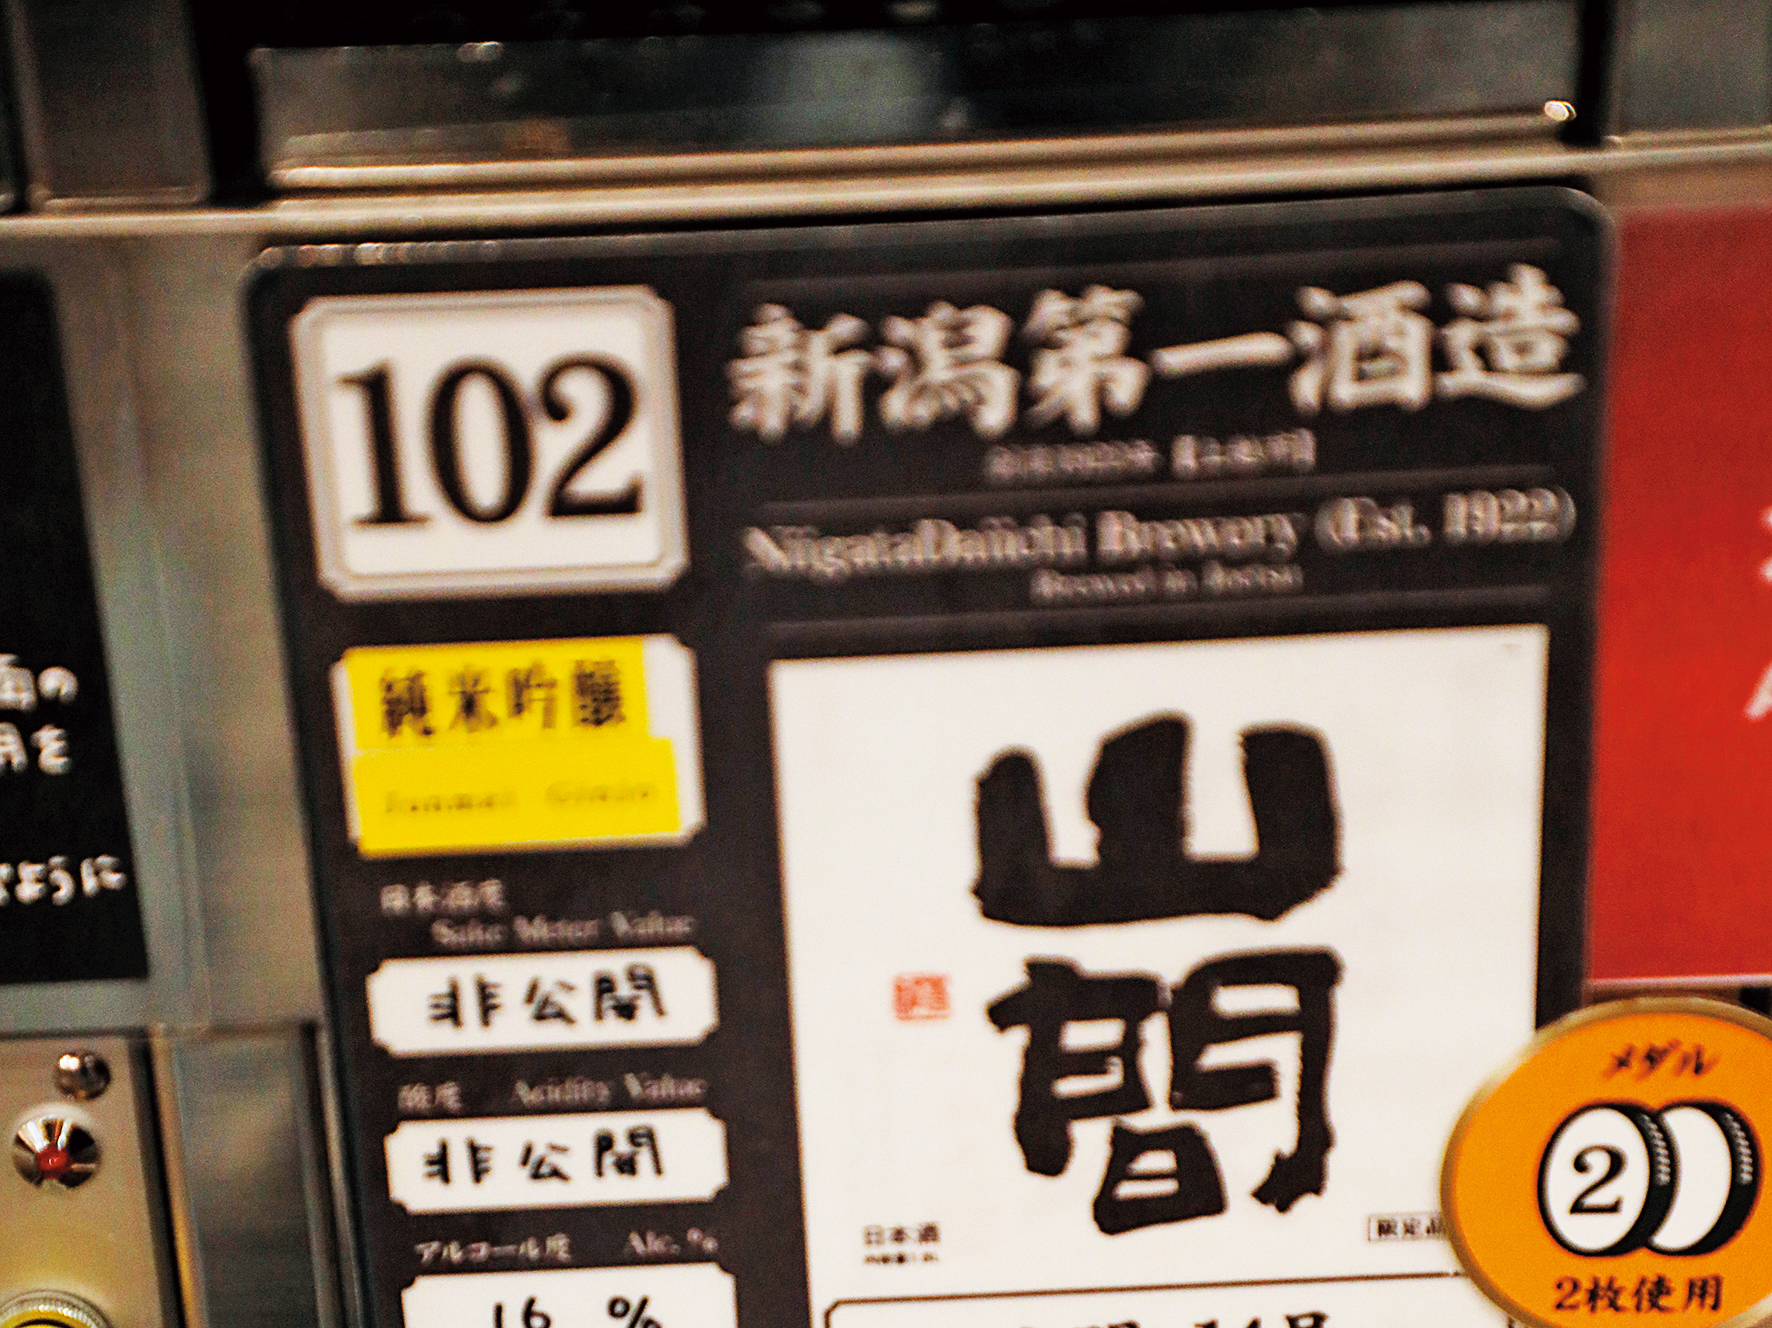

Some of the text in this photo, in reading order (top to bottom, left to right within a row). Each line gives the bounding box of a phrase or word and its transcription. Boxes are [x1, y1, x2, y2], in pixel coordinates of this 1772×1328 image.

[725, 261, 1587, 444] 新潟第一酒造
[335, 351, 645, 528] 102
[427, 961, 668, 1029] 非公開
[971, 709, 1347, 1236] 山間
[1602, 1038, 1721, 1081] メダル
[422, 1124, 666, 1186] 非公開
[1569, 1144, 1628, 1215] 2
[415, 1232, 573, 1266] アルコール度
[1555, 1273, 1726, 1315] 2枚使用
